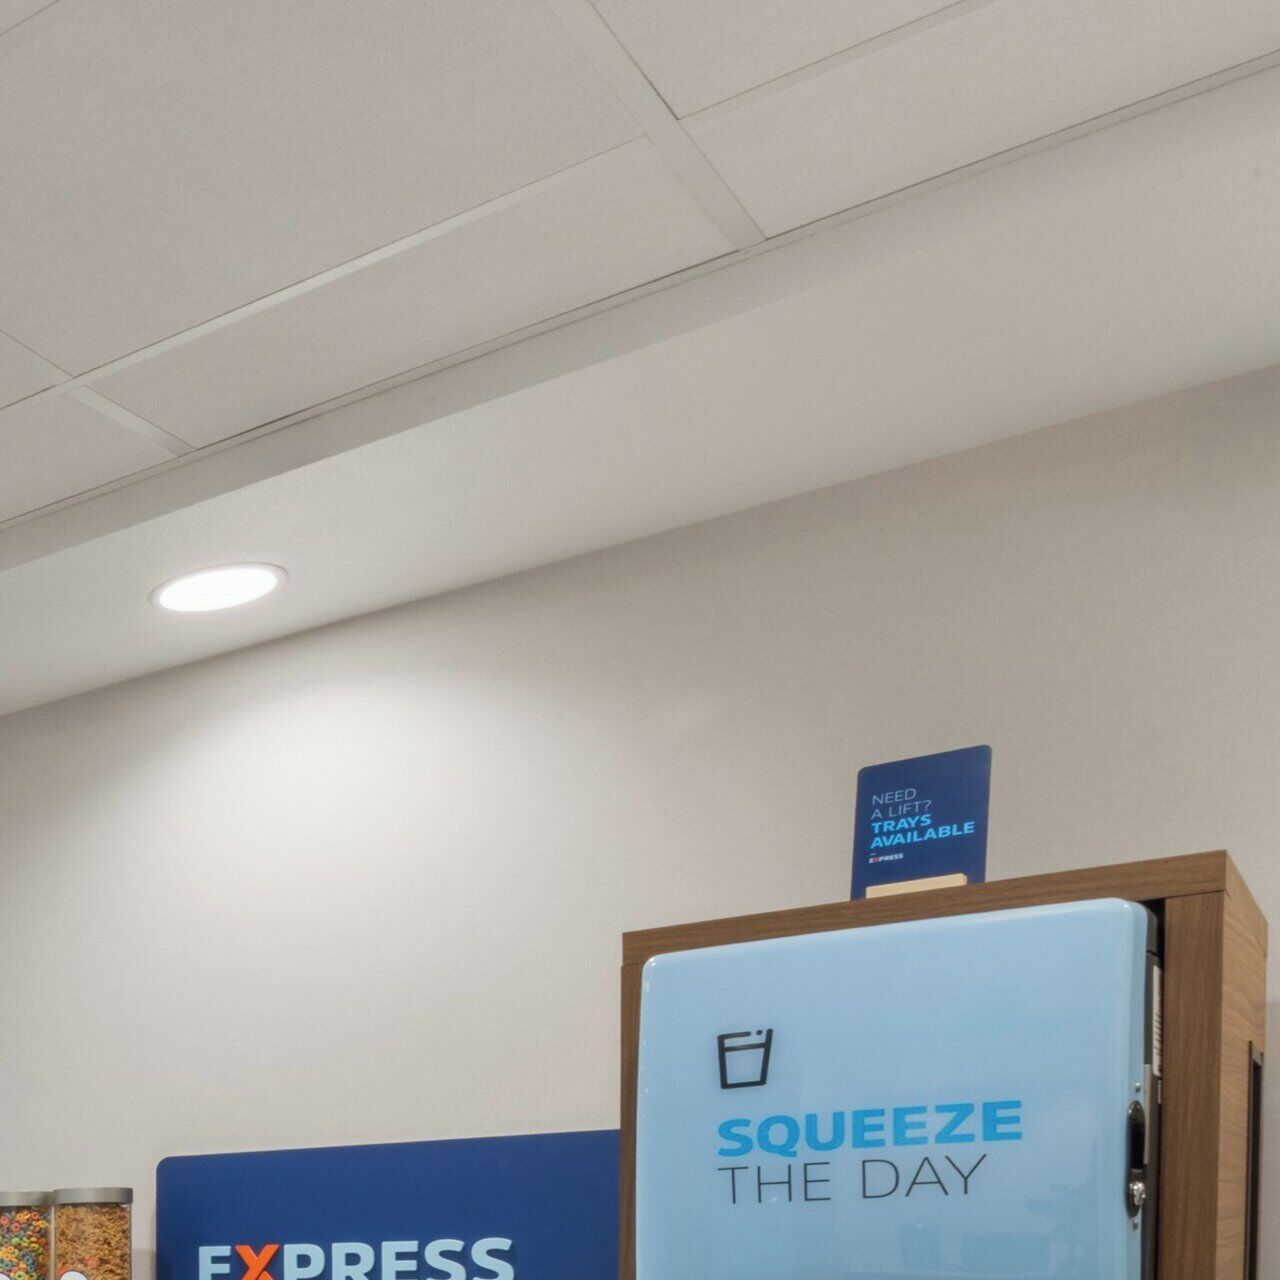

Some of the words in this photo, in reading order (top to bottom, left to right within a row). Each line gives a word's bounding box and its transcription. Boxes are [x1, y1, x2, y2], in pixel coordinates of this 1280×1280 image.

[872, 788, 917, 806] NEED
[870, 809, 883, 820] A
[888, 799, 932, 817] LIFT?
[871, 813, 932, 834] TRAYS
[870, 821, 975, 849] AVAILABLE
[868, 852, 904, 864] EXPRESS
[717, 1100, 1023, 1158] SQUEEZE
[717, 1161, 832, 1204] THE
[861, 1153, 987, 1199] DAY
